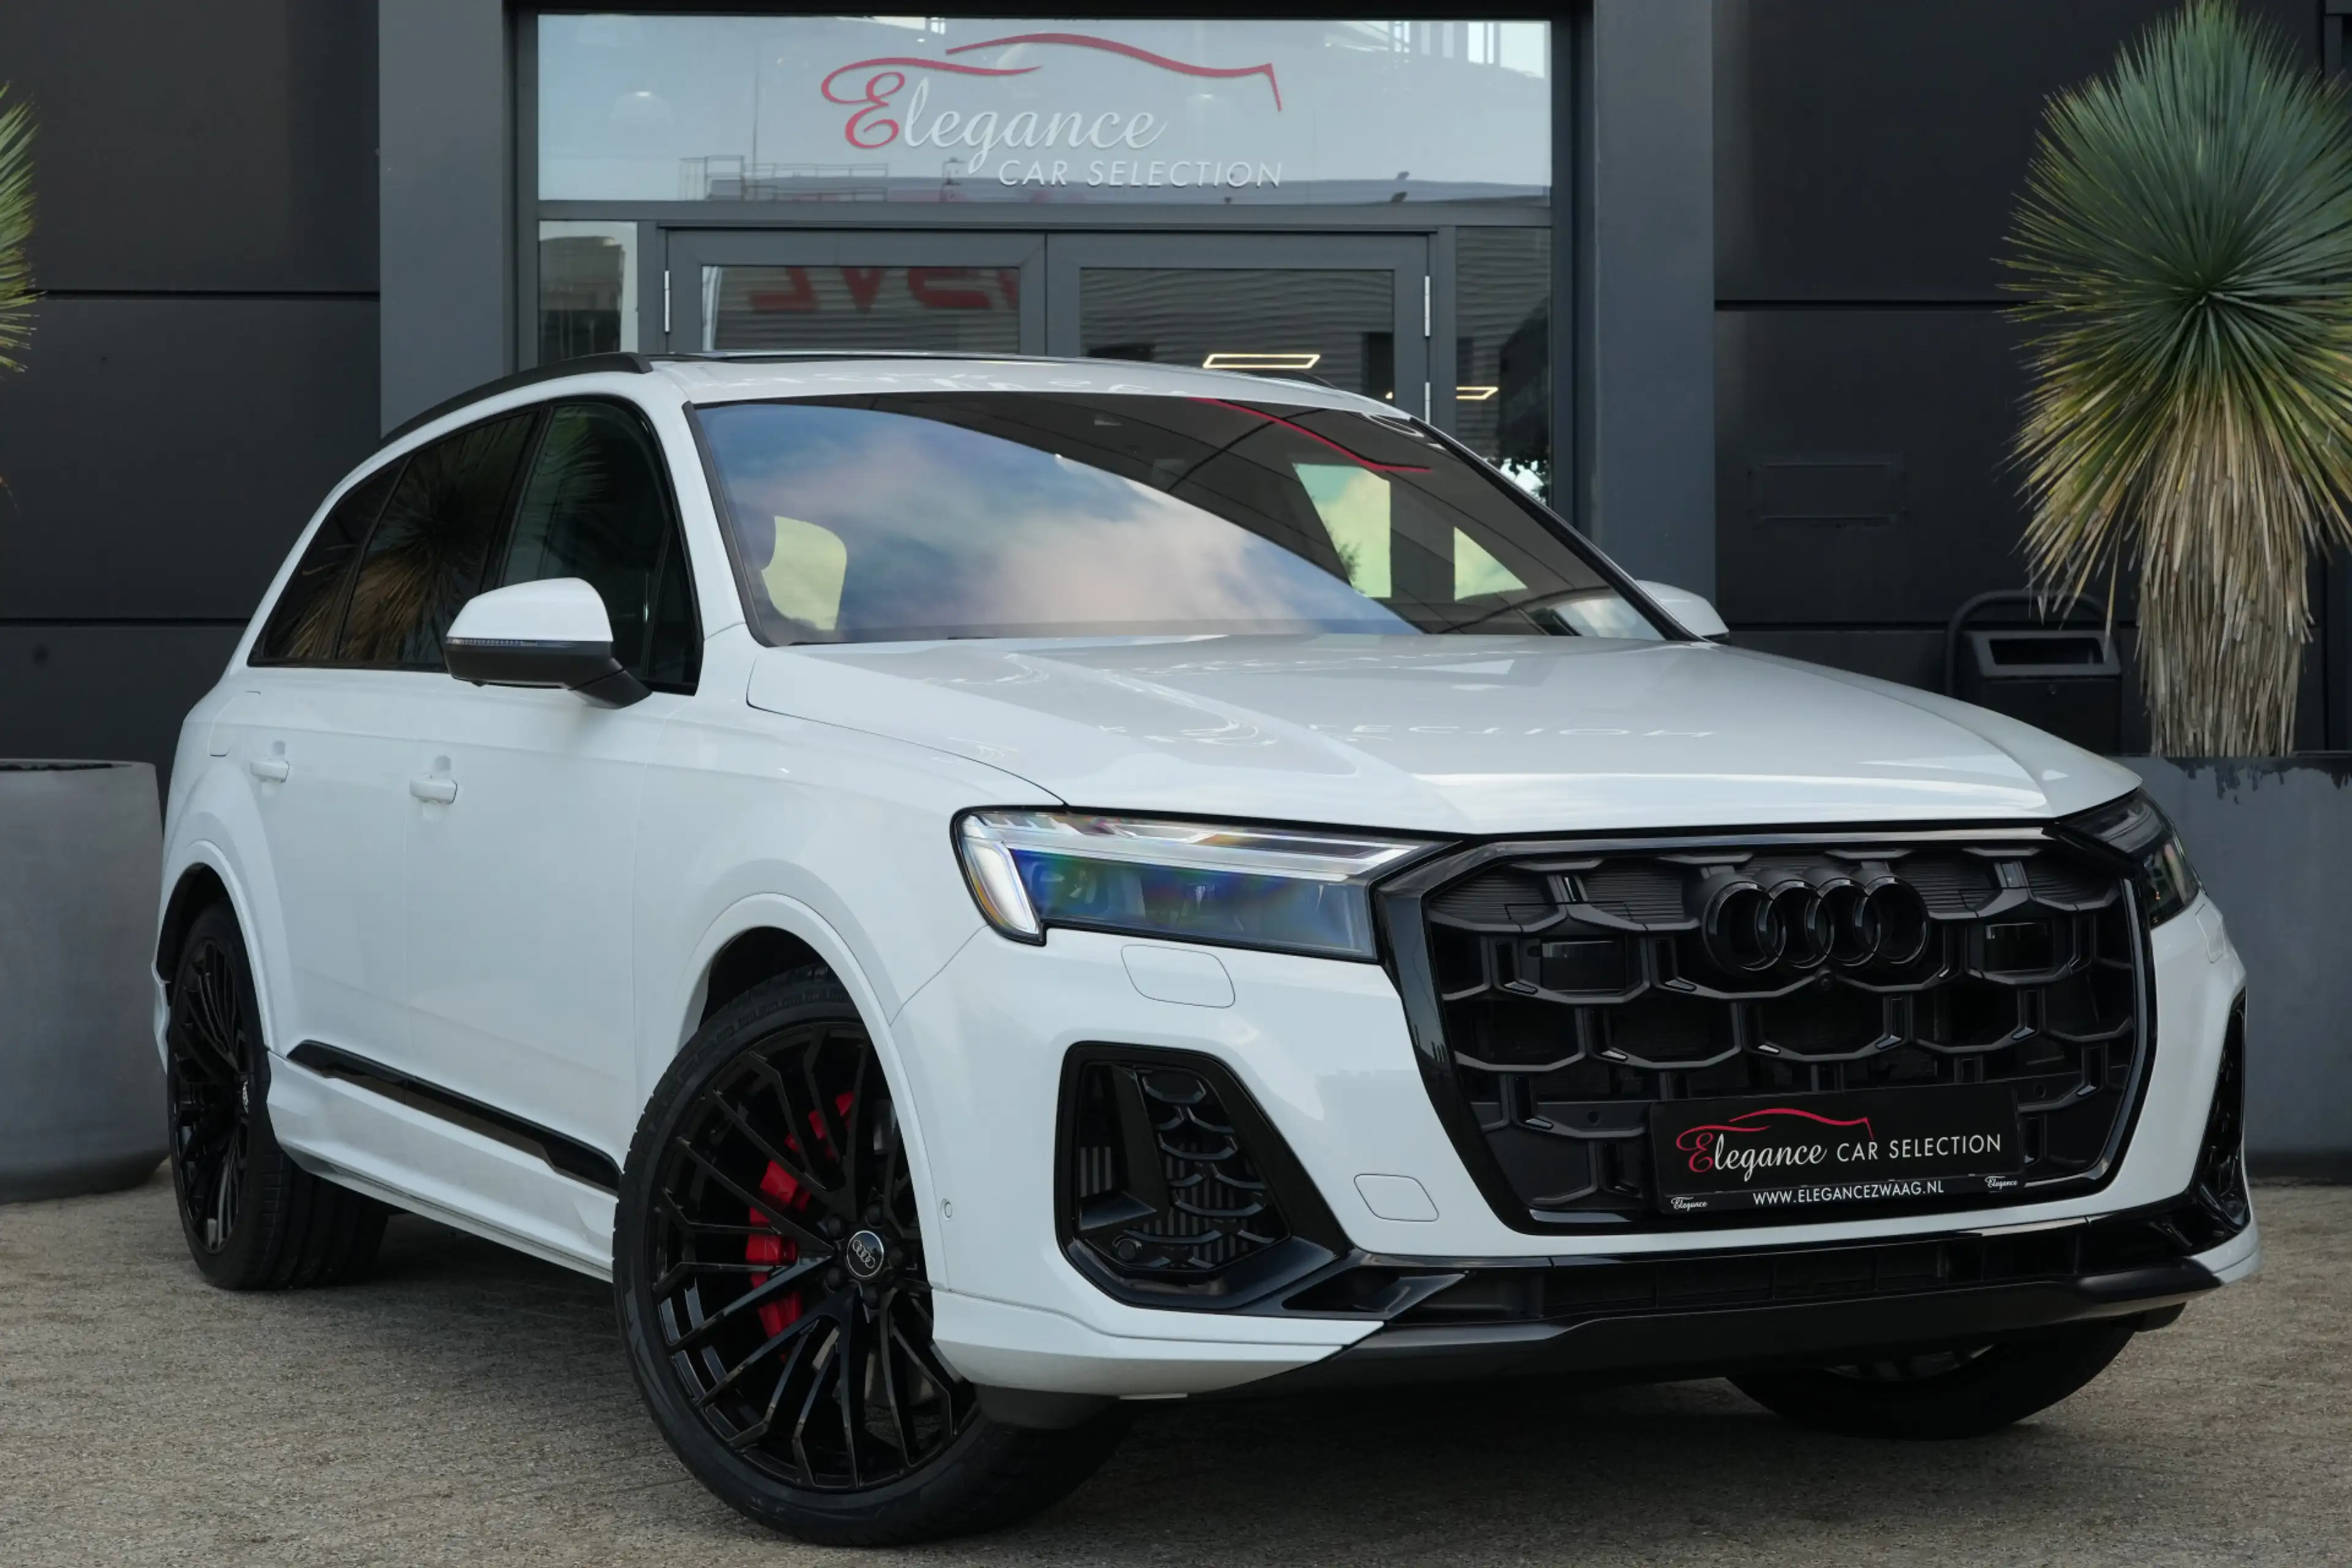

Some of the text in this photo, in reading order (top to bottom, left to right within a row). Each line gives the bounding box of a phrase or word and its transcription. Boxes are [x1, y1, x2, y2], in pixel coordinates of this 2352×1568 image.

[821, 57, 1167, 175] Elegance
[998, 160, 1283, 189] CAR SELECTION
[1676, 1125, 2001, 1182] Elegance CAR SELECTION
[1671, 1196, 1708, 1212] Elegance
[1752, 1180, 1945, 1206] WWW.ELEGANCEZWAAG.NL
